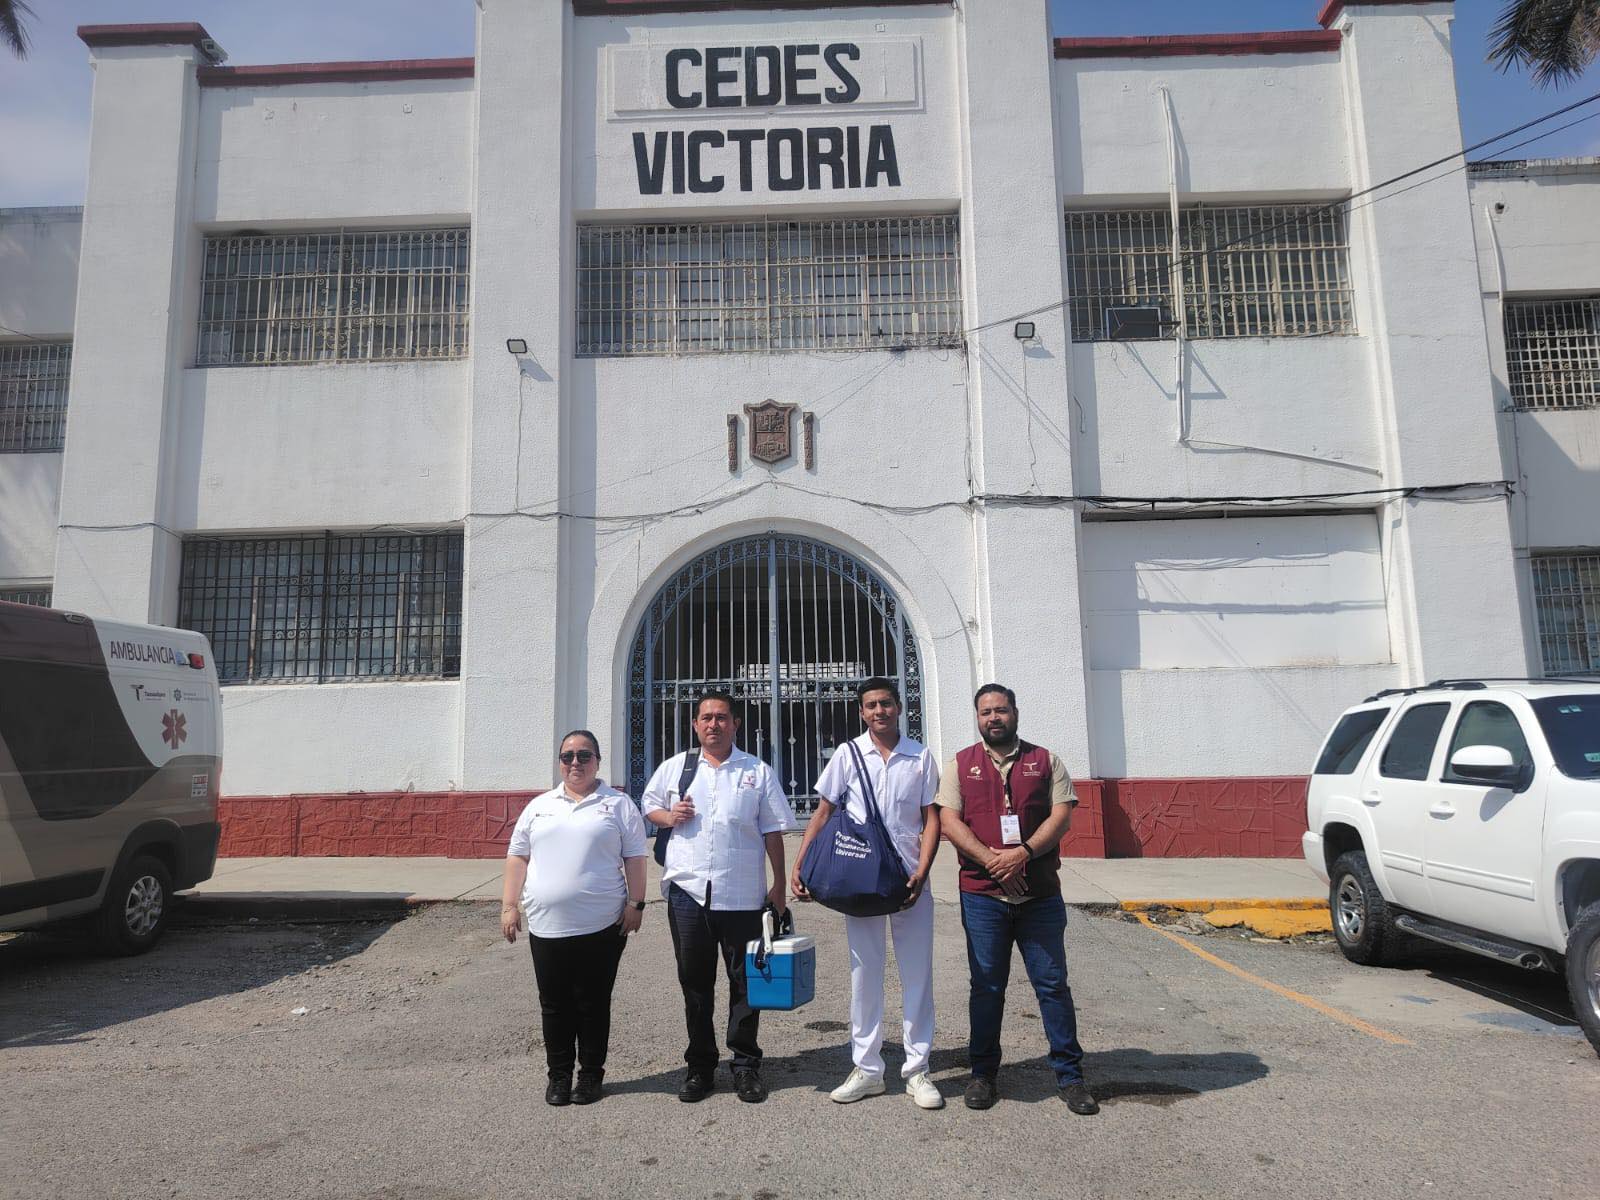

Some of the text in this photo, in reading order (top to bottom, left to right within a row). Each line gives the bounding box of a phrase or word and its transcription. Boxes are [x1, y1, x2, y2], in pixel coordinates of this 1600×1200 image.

[665, 43, 861, 109] CEDES
[632, 124, 901, 195] VICTORIA
[110, 641, 176, 664] AMBULANCIA
[835, 848, 867, 859] Universal
